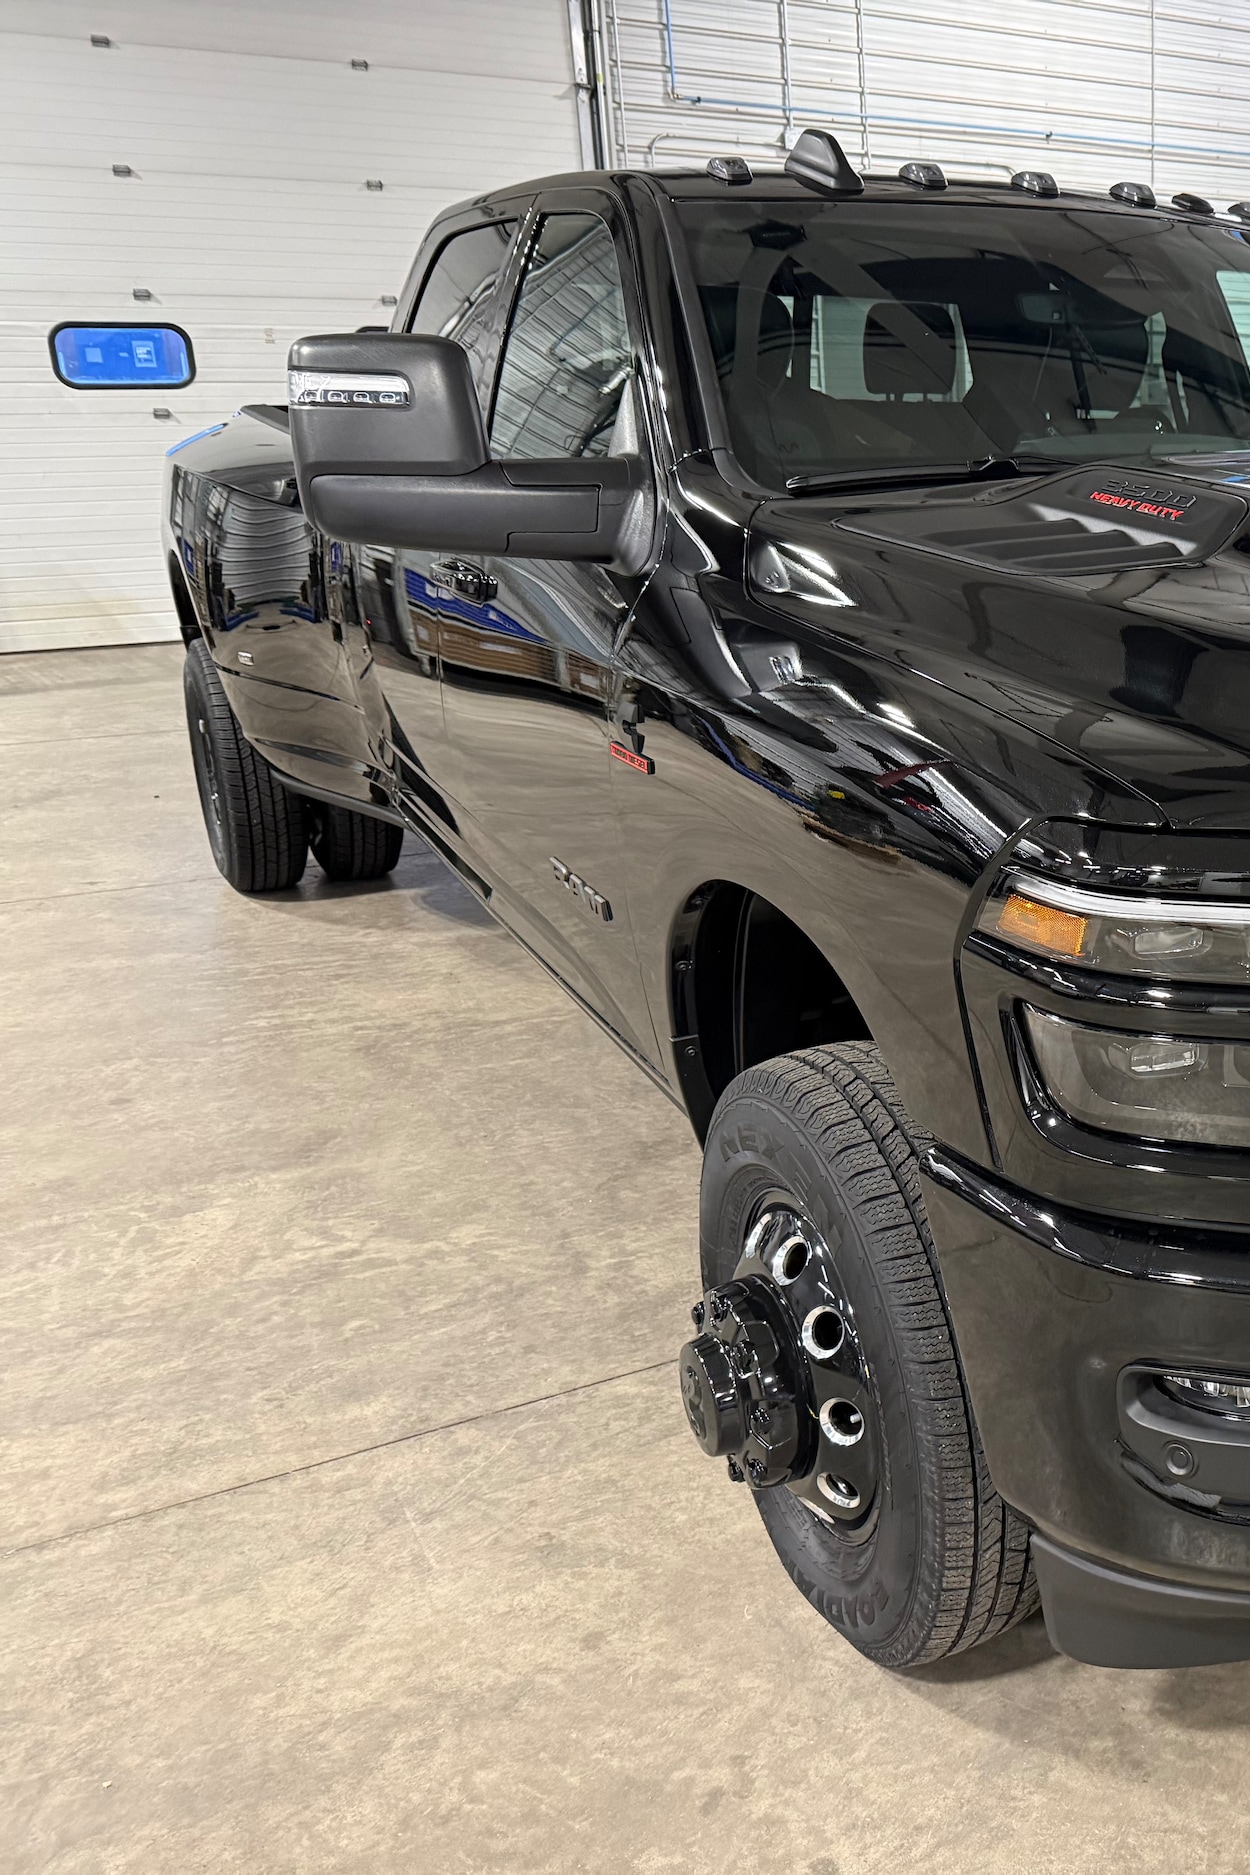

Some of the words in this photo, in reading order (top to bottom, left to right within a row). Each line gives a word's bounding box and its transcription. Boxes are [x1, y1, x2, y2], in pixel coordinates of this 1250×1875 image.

[1090, 491, 1141, 510] HEAVY
[1136, 502, 1185, 521] DUTY
[1101, 479, 1197, 509] 3500
[549, 856, 613, 922] RAM
